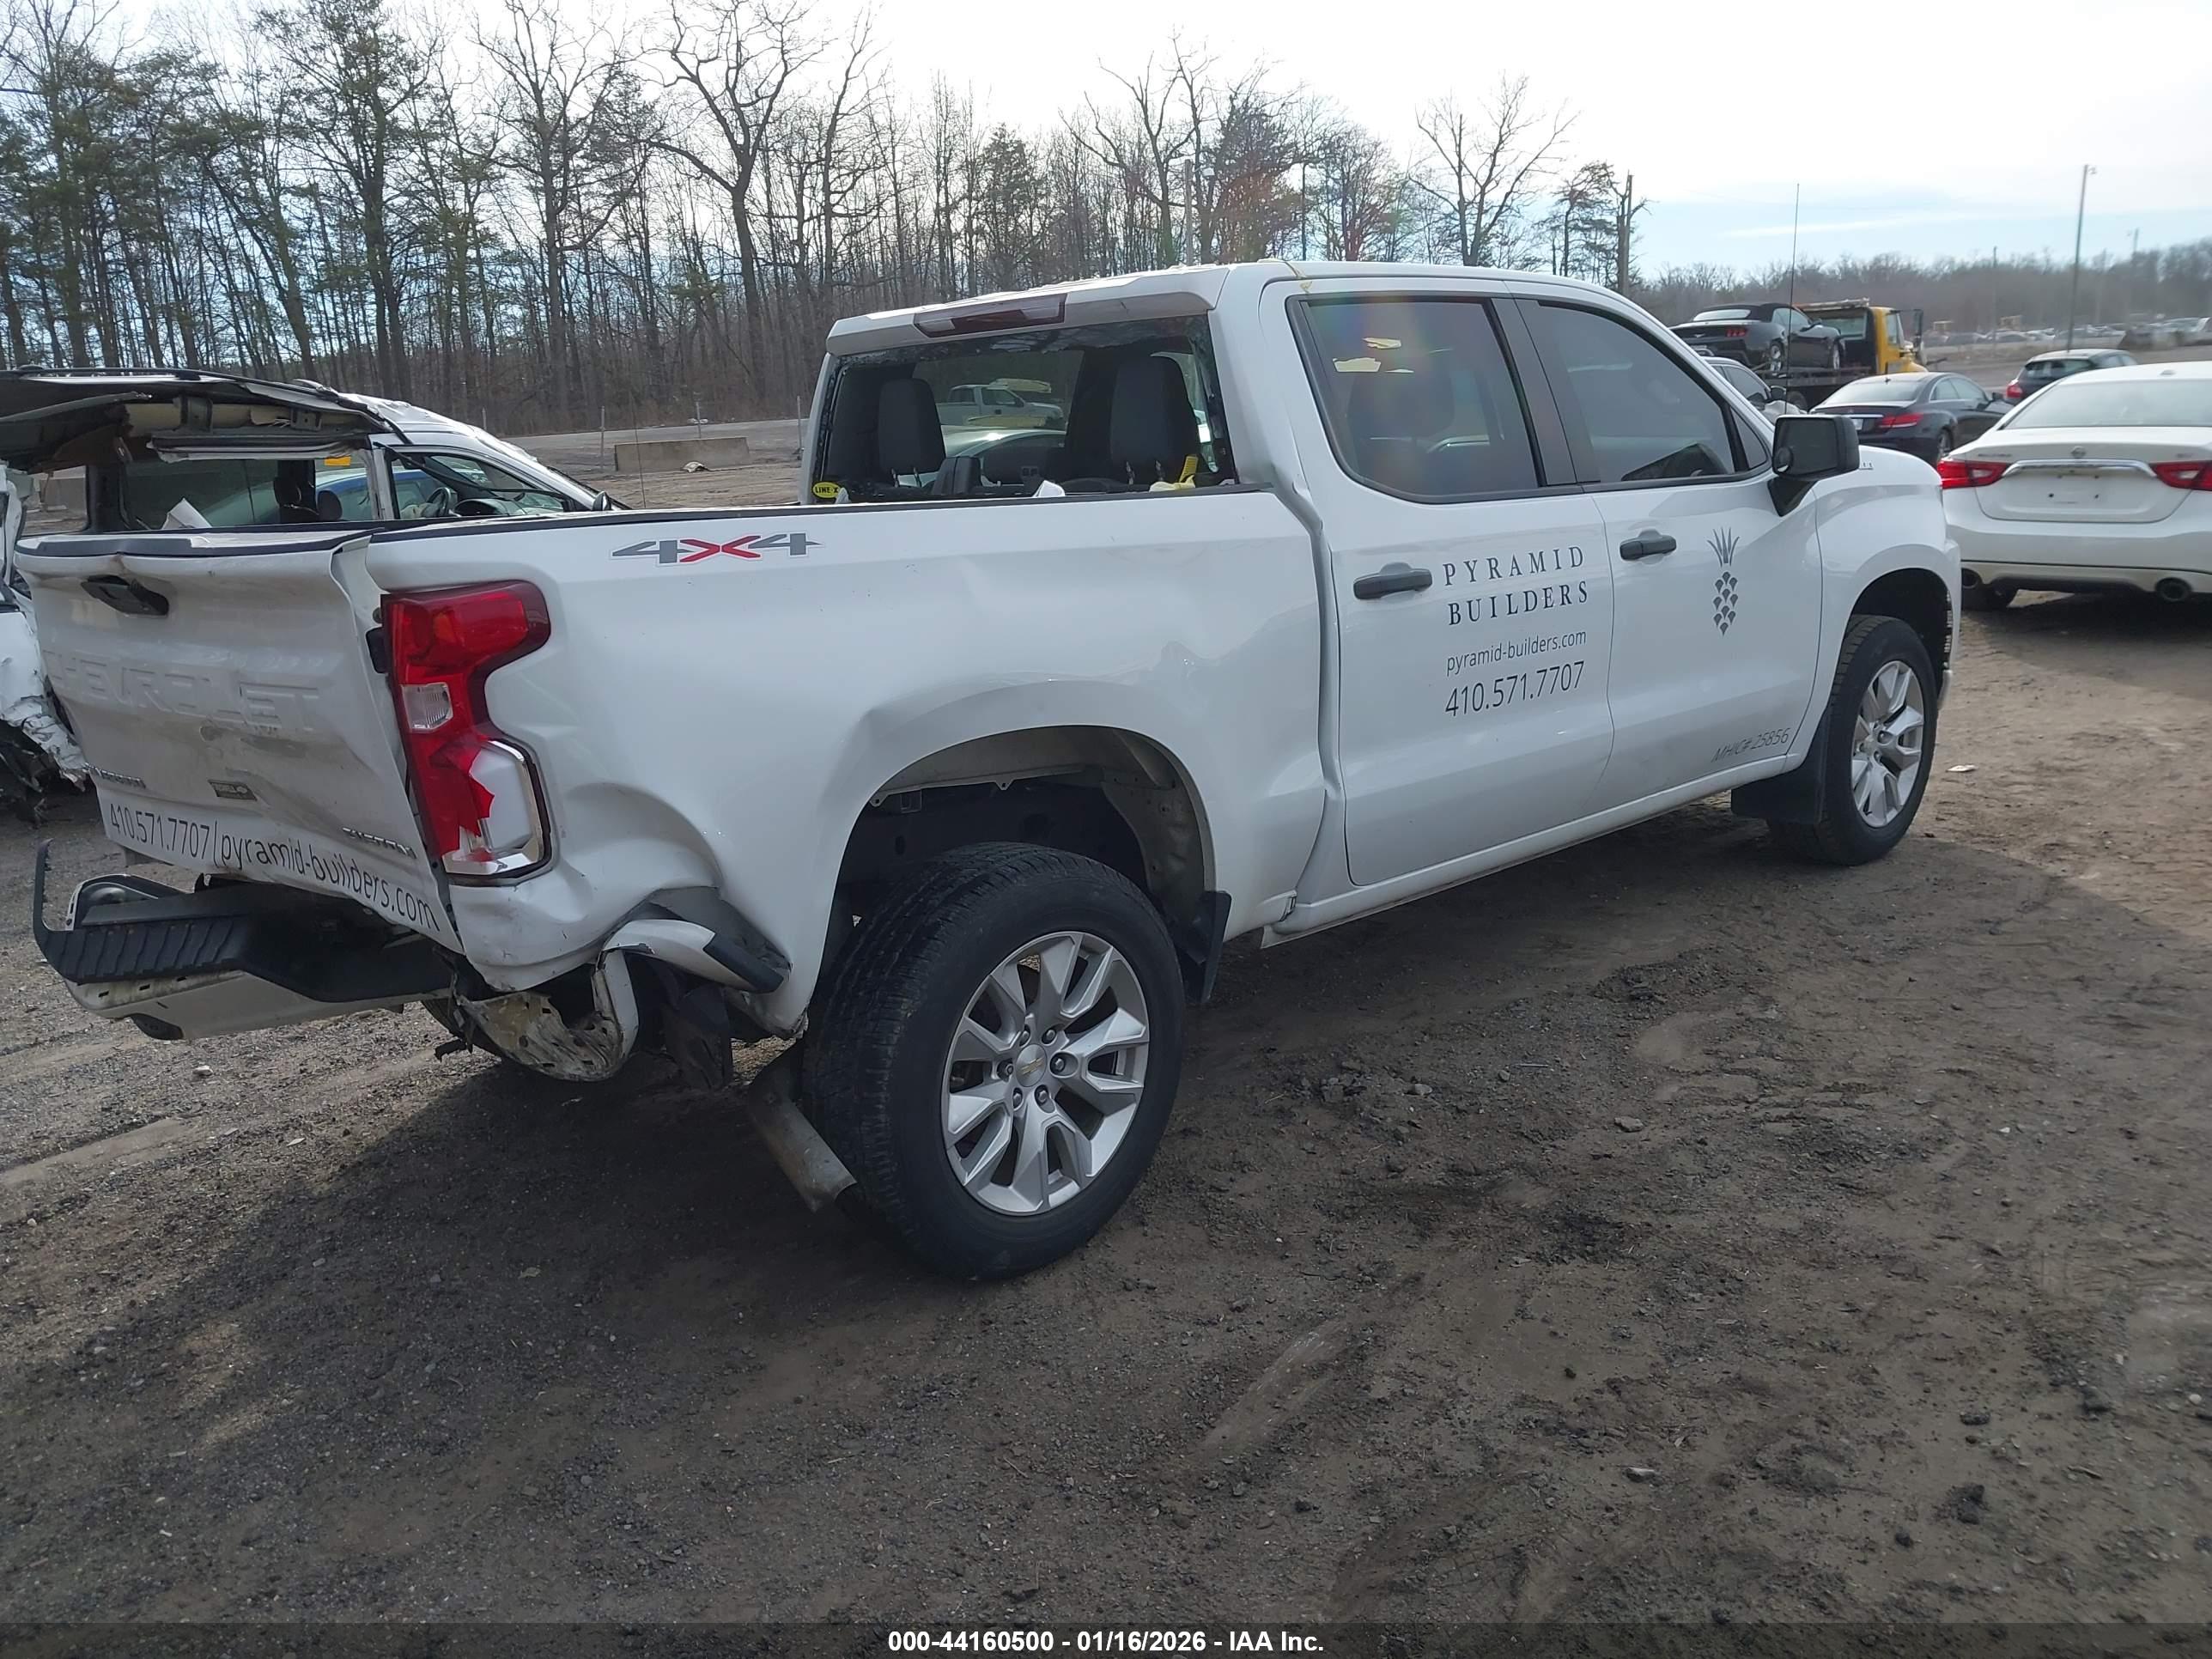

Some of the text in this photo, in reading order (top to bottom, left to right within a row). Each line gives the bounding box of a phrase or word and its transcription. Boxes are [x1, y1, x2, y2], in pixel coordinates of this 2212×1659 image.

[1443, 546, 1583, 586] PYRAMID
[1448, 580, 1588, 625] BUILDERS
[1446, 631, 1587, 677] pyramid-builders.com
[1445, 660, 1585, 717] 410.571.7707
